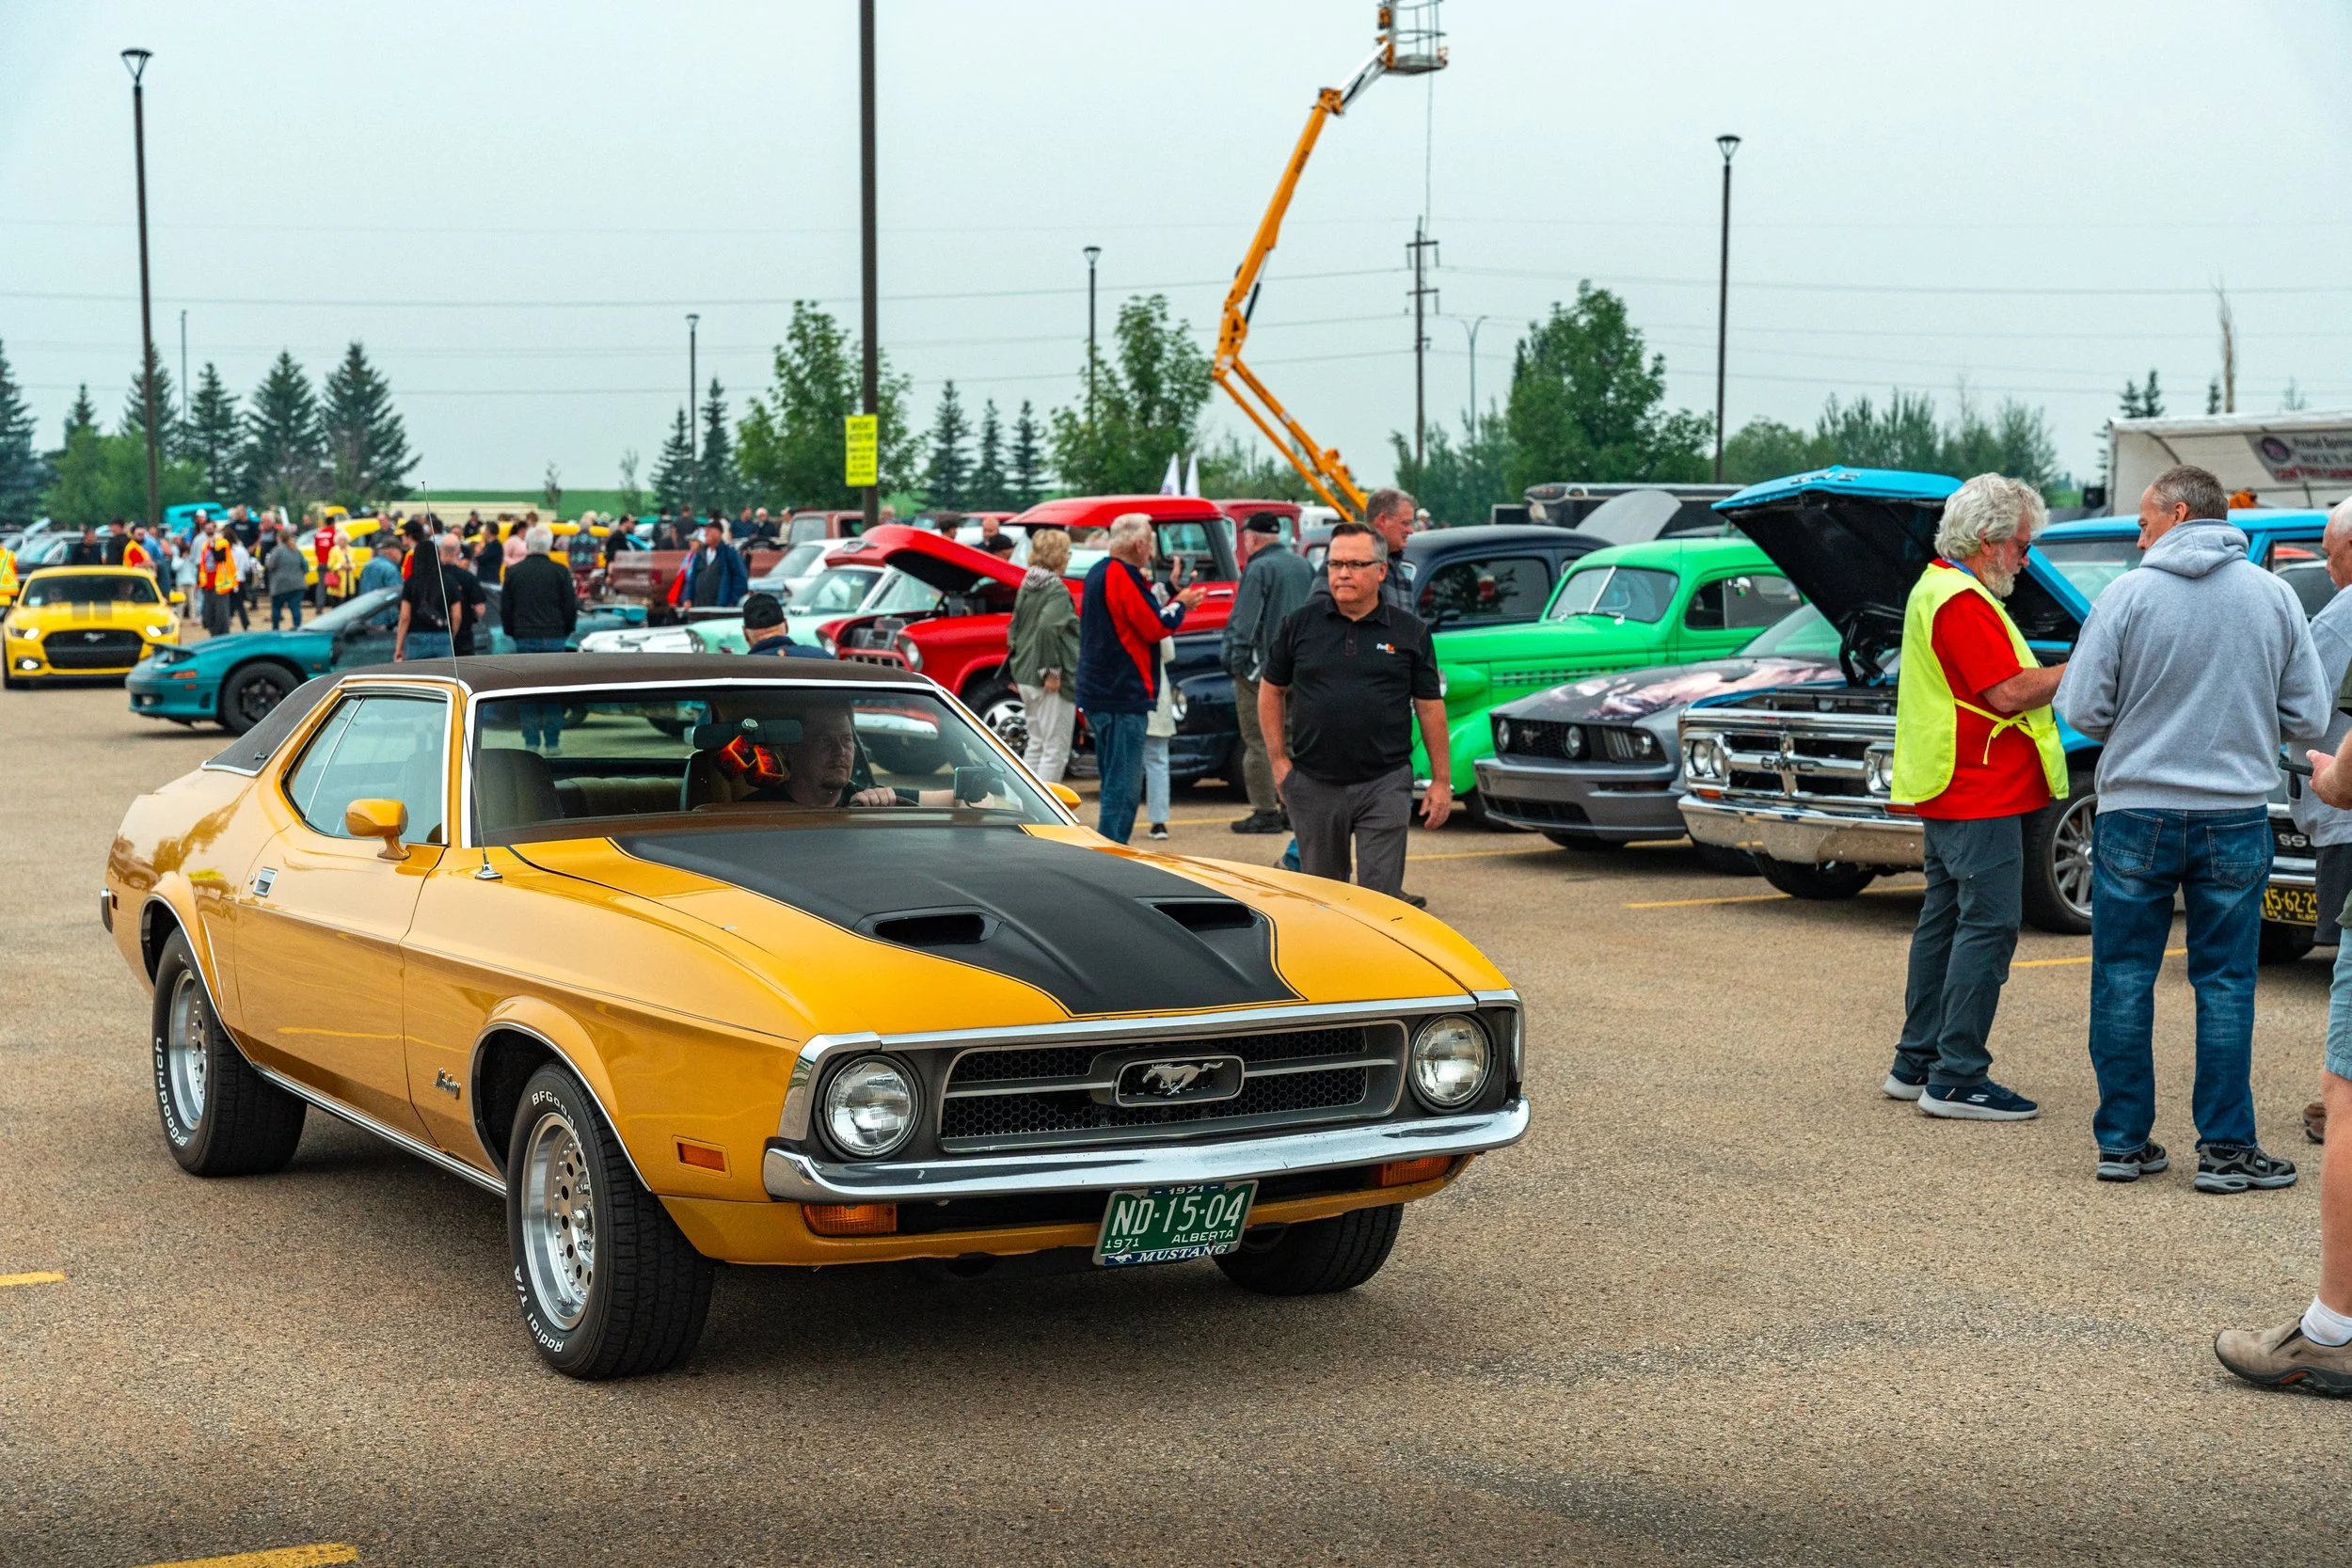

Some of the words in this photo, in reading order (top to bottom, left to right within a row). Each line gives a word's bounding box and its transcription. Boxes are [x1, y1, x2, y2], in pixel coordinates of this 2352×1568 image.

[1760, 756, 1815, 772] GMC
[2279, 833, 2307, 847] SS
[155, 1037, 188, 1147] BFGoodrich
[1168, 1185, 1204, 1195] 1971
[1104, 1238, 1139, 1249] 1971
[1171, 1229, 1233, 1243] ALBERTA
[1136, 1244, 1229, 1262] MUSTANG
[514, 1264, 528, 1307] T/A
[527, 1312, 564, 1353] Radial
